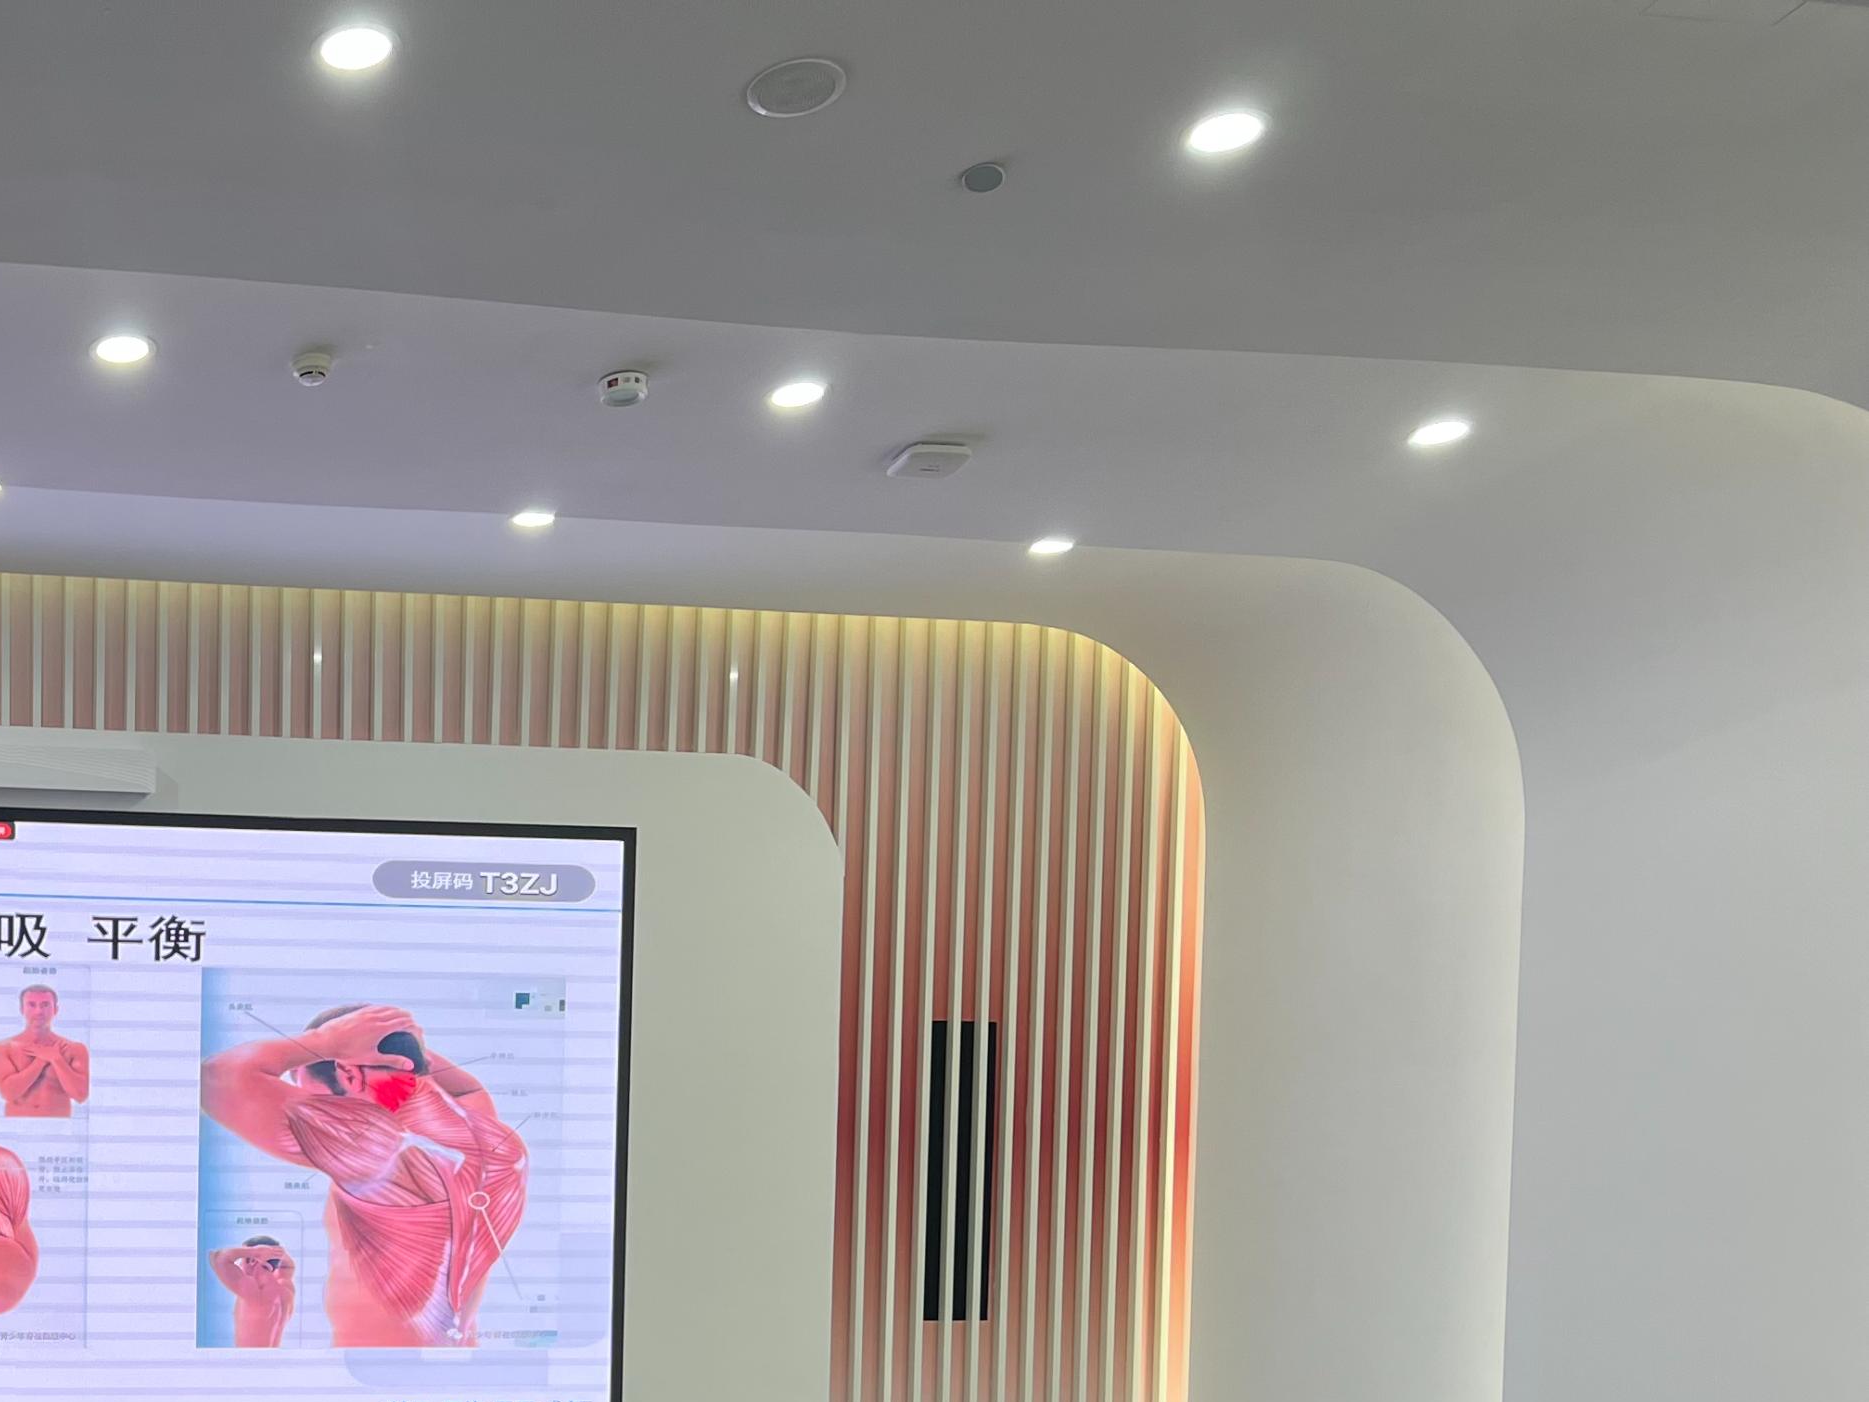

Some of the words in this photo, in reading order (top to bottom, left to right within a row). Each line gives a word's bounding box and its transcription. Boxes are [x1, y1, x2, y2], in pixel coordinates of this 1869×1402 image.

[410, 870, 474, 892] 投屏码
[479, 870, 560, 898] T3ZJ
[86, 912, 207, 965] 平衡
